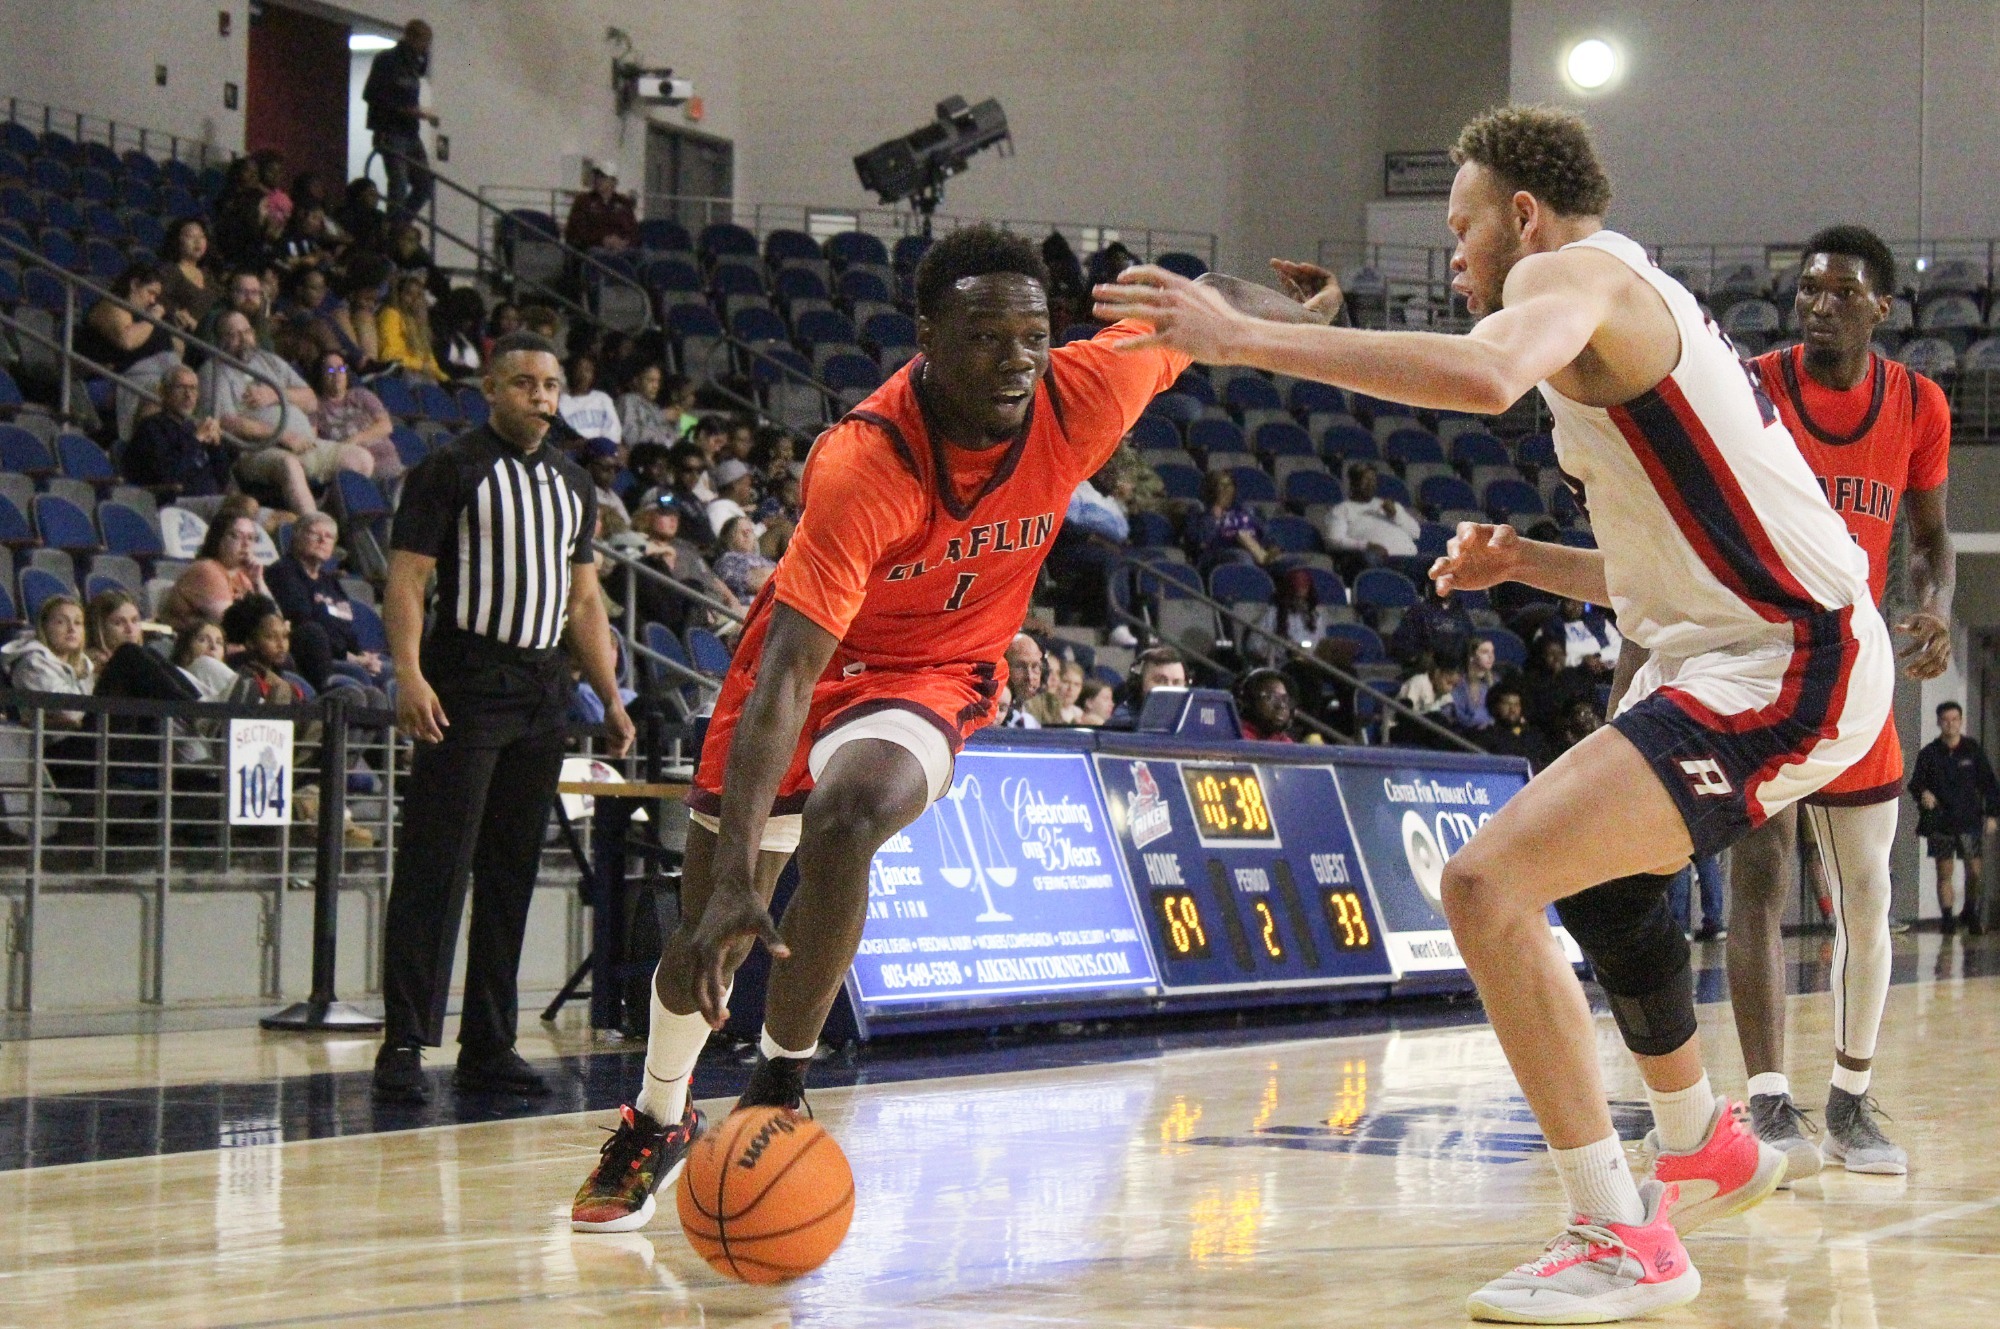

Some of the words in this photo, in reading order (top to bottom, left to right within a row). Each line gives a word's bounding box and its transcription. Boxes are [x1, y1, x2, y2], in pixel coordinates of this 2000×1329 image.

[943, 572, 979, 611] 1
[236, 724, 285, 750] SECTION
[236, 763, 285, 818] 104
[1001, 777, 1094, 840] Celebrating
[1196, 776, 1269, 831] 10:38
[1038, 825, 1070, 872] 35
[1142, 852, 1185, 886] HOME
[1310, 853, 1350, 884] GUEST
[1234, 867, 1270, 892] PERIOD
[866, 901, 890, 920] AW
[893, 901, 929, 919] FIRM
[1164, 896, 1206, 953] 69
[1256, 902, 1281, 957] 2
[1331, 893, 1369, 946] 33
[880, 960, 963, 989] 803-649-5338
[975, 951, 1132, 984] AIKENATTORNEYS.COM
